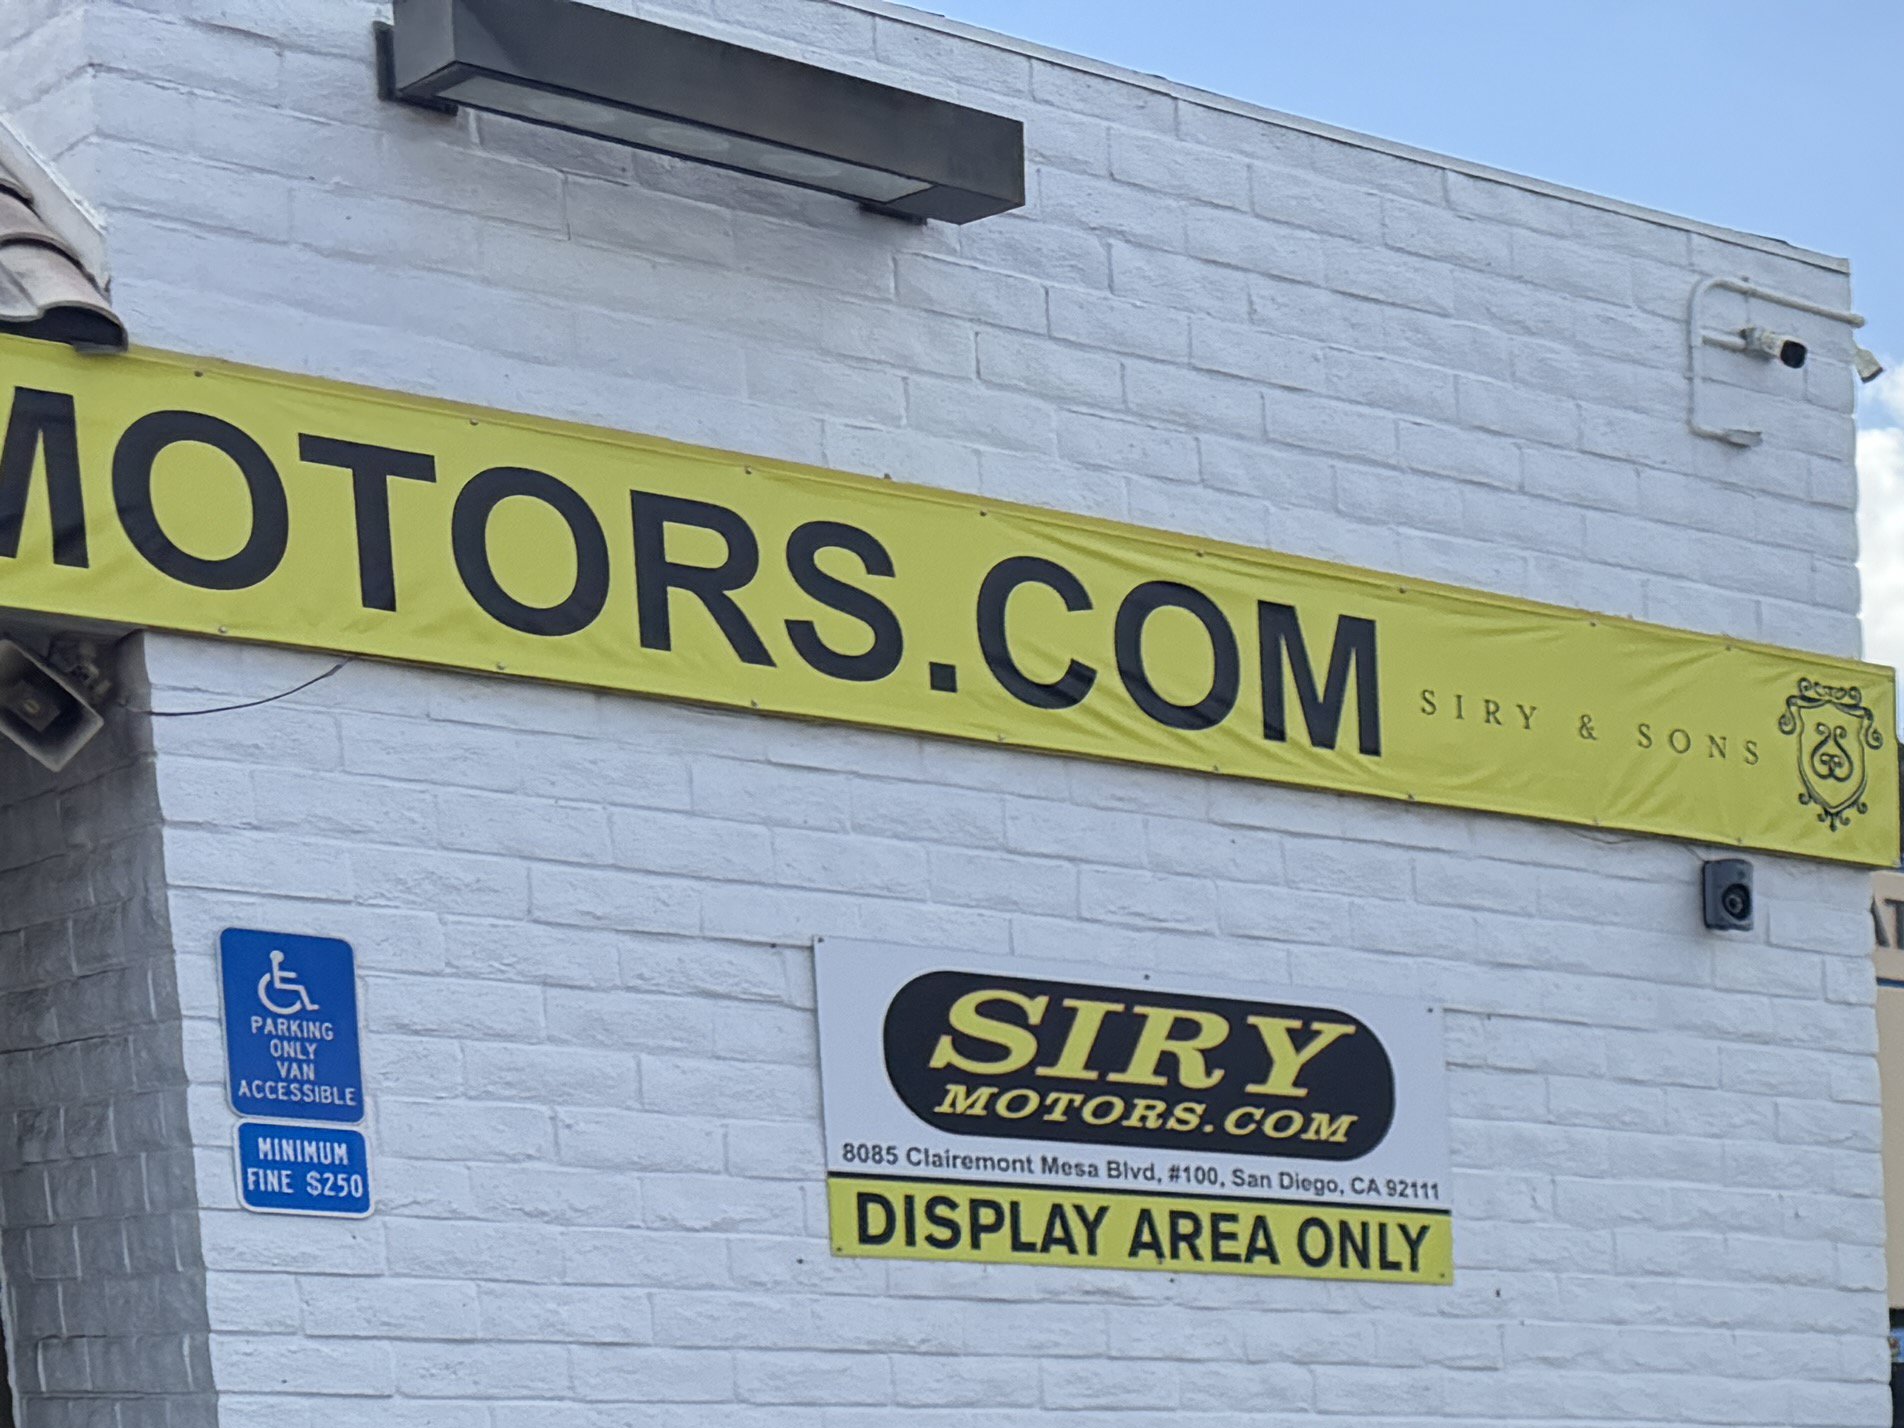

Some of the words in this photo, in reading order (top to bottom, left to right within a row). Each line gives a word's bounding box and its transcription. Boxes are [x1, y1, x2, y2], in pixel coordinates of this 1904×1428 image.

[1420, 688, 1542, 732] SIRY
[1578, 714, 1600, 743] &
[1637, 721, 1761, 768] SONS
[250, 1016, 334, 1042] PARKING
[928, 988, 1356, 1098] SIRY
[269, 1038, 318, 1061] ONLY
[276, 1060, 316, 1081] VAN
[237, 1079, 358, 1107] ACCESSIBLE
[934, 1084, 1358, 1144] MOTORS.COM
[257, 1137, 348, 1166] MINIMUM
[246, 1168, 294, 1195] FINE
[306, 1171, 364, 1199] $250
[841, 1142, 899, 1166] 8085
[905, 1146, 1035, 1175] Clairemont
[1040, 1156, 1100, 1180] Mesa
[1106, 1158, 1163, 1186] Blvd,
[1168, 1163, 1227, 1190] #100,
[1231, 1168, 1273, 1191] San
[1278, 1171, 1346, 1199] Diego,
[1351, 1175, 1383, 1198] CA
[1386, 1178, 1440, 1200] 92111
[855, 1191, 1110, 1256] DISPLAY
[1127, 1207, 1280, 1266] AREA
[1296, 1215, 1431, 1275] ONLY
